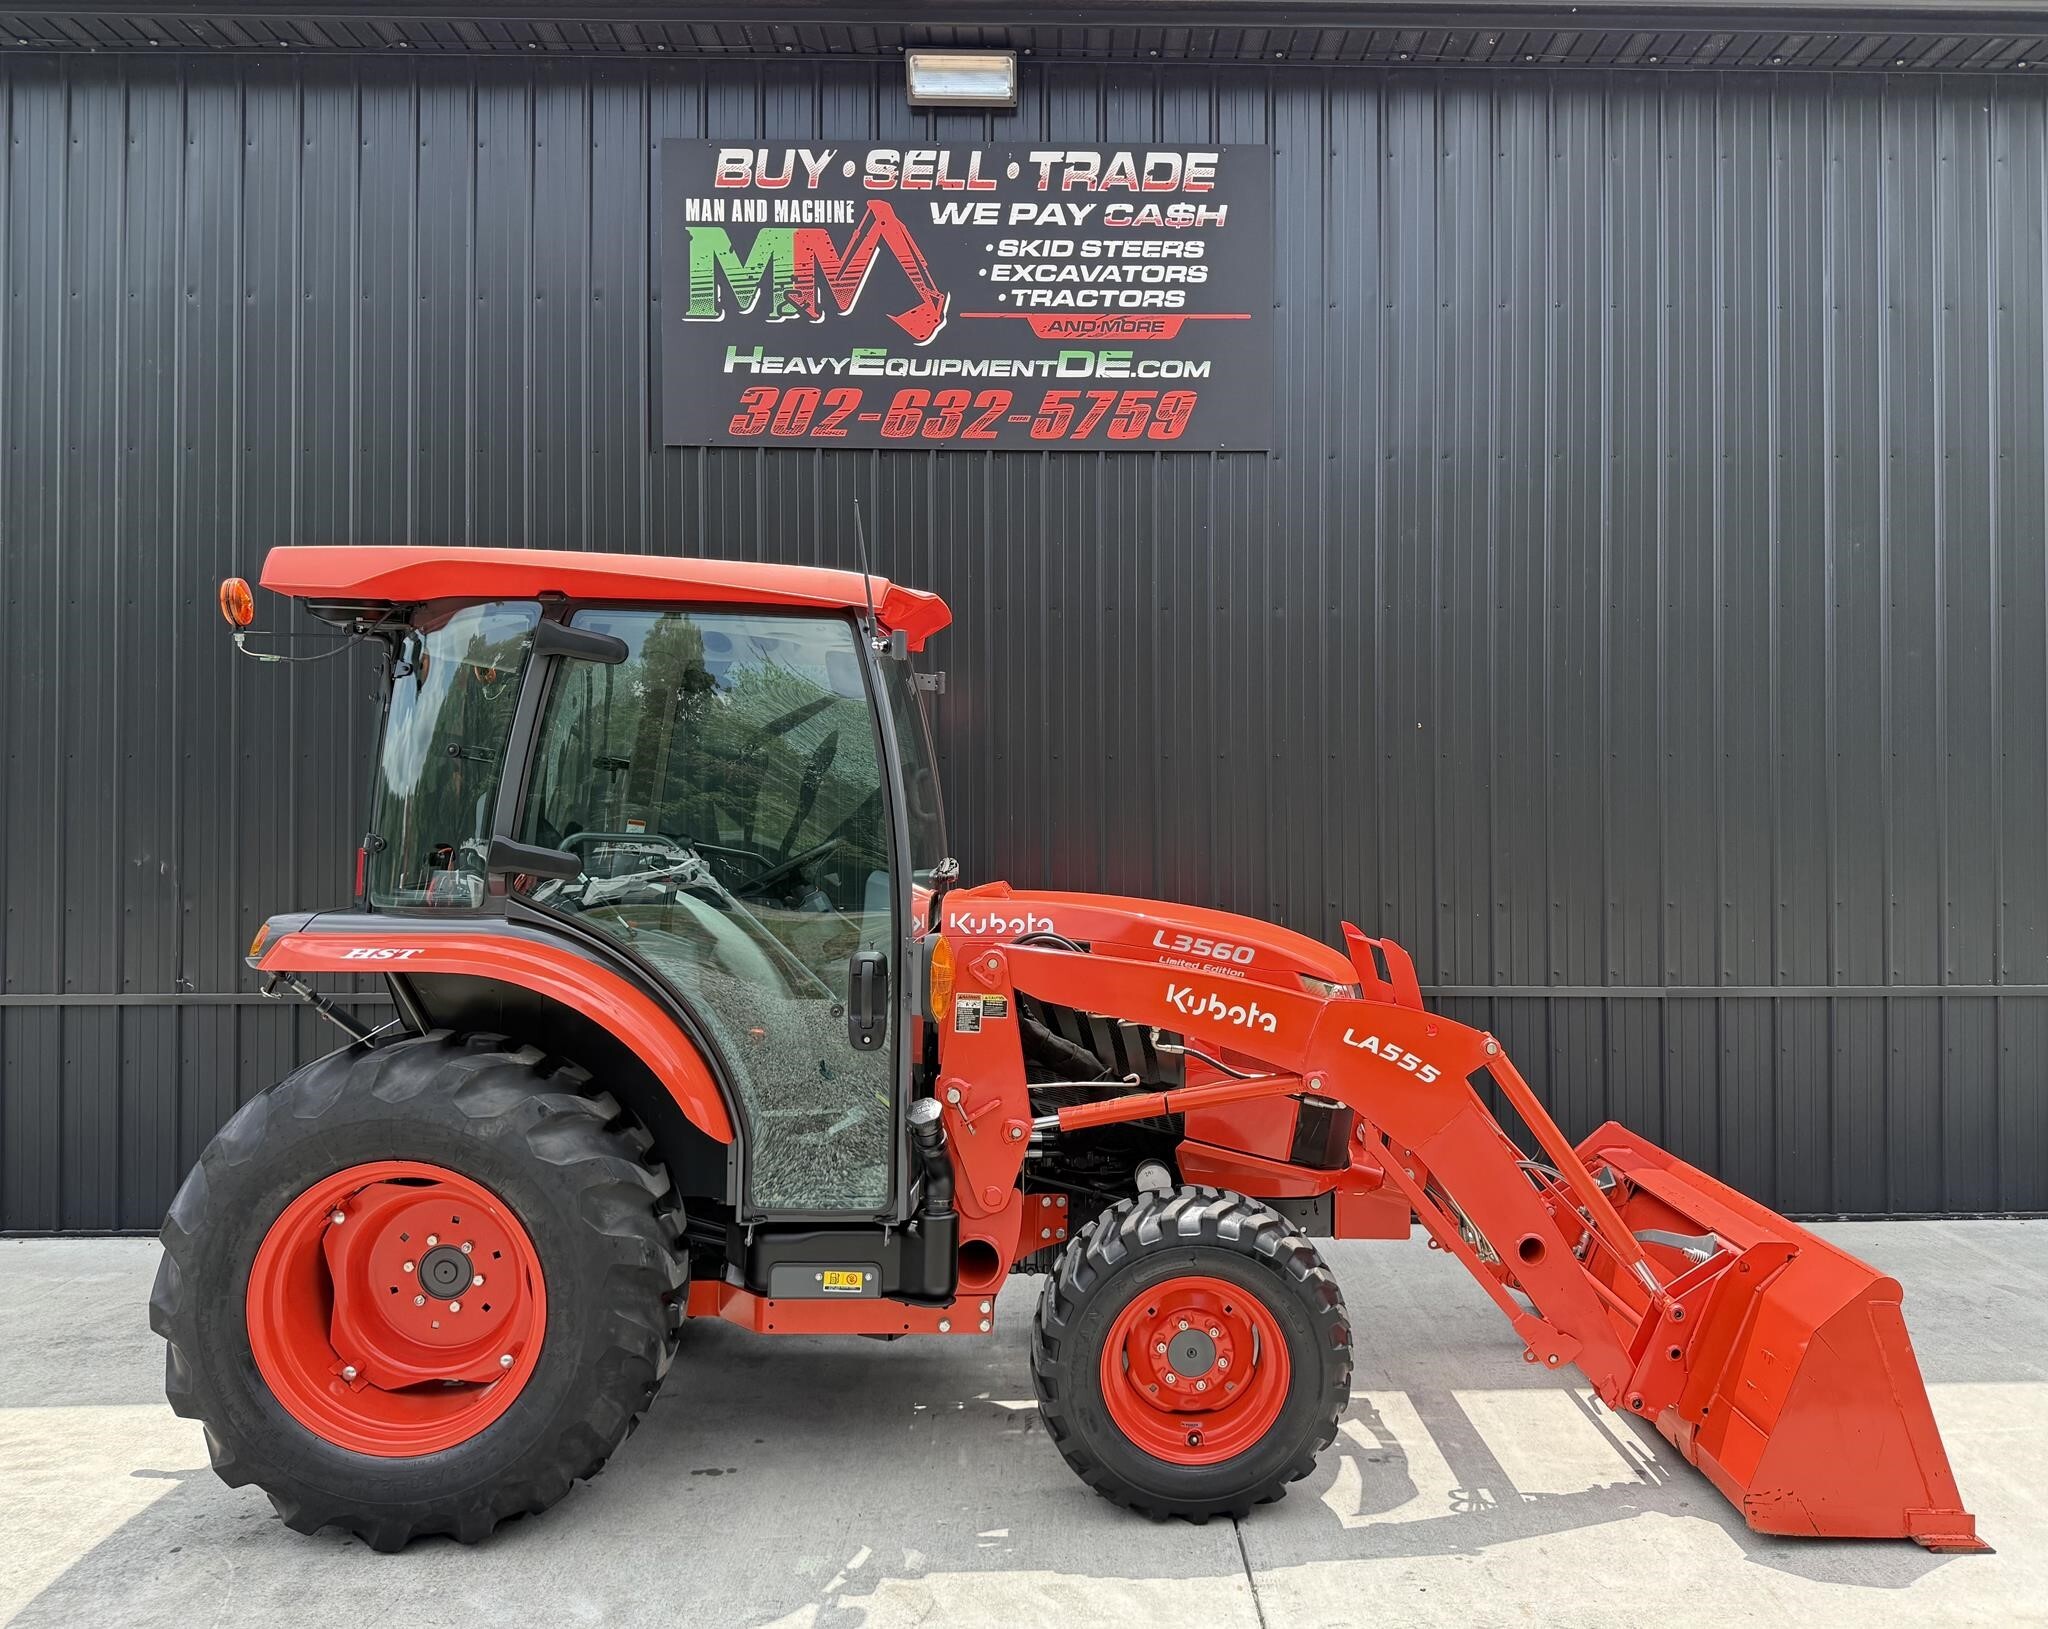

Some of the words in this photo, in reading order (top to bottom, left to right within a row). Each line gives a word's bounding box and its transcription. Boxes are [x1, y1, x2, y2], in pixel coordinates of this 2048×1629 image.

[714, 148, 838, 189] BUY
[863, 149, 997, 191] SELL
[1029, 152, 1220, 192] TRADE
[685, 198, 725, 222] MAN
[732, 199, 768, 222] AND
[774, 199, 855, 223] MACHINE
[929, 202, 1002, 226] WE
[1008, 203, 1097, 226] PAY
[997, 239, 1074, 258] SKID
[1080, 240, 1205, 258] STEERS
[990, 264, 1209, 283] EXCAVATORS
[1011, 289, 1186, 308] TRACTORS
[1048, 320, 1097, 333] AND
[1099, 320, 1166, 333] MORE
[728, 386, 1199, 441] 302-632-5759
[949, 912, 1055, 935] Kubota
[339, 947, 425, 960] HST
[1152, 929, 1256, 965] L3560
[1158, 955, 1200, 970] Limited
[1203, 963, 1246, 978] Edition
[1166, 983, 1277, 1033] Kubota
[1343, 1028, 1442, 1083] LA555
